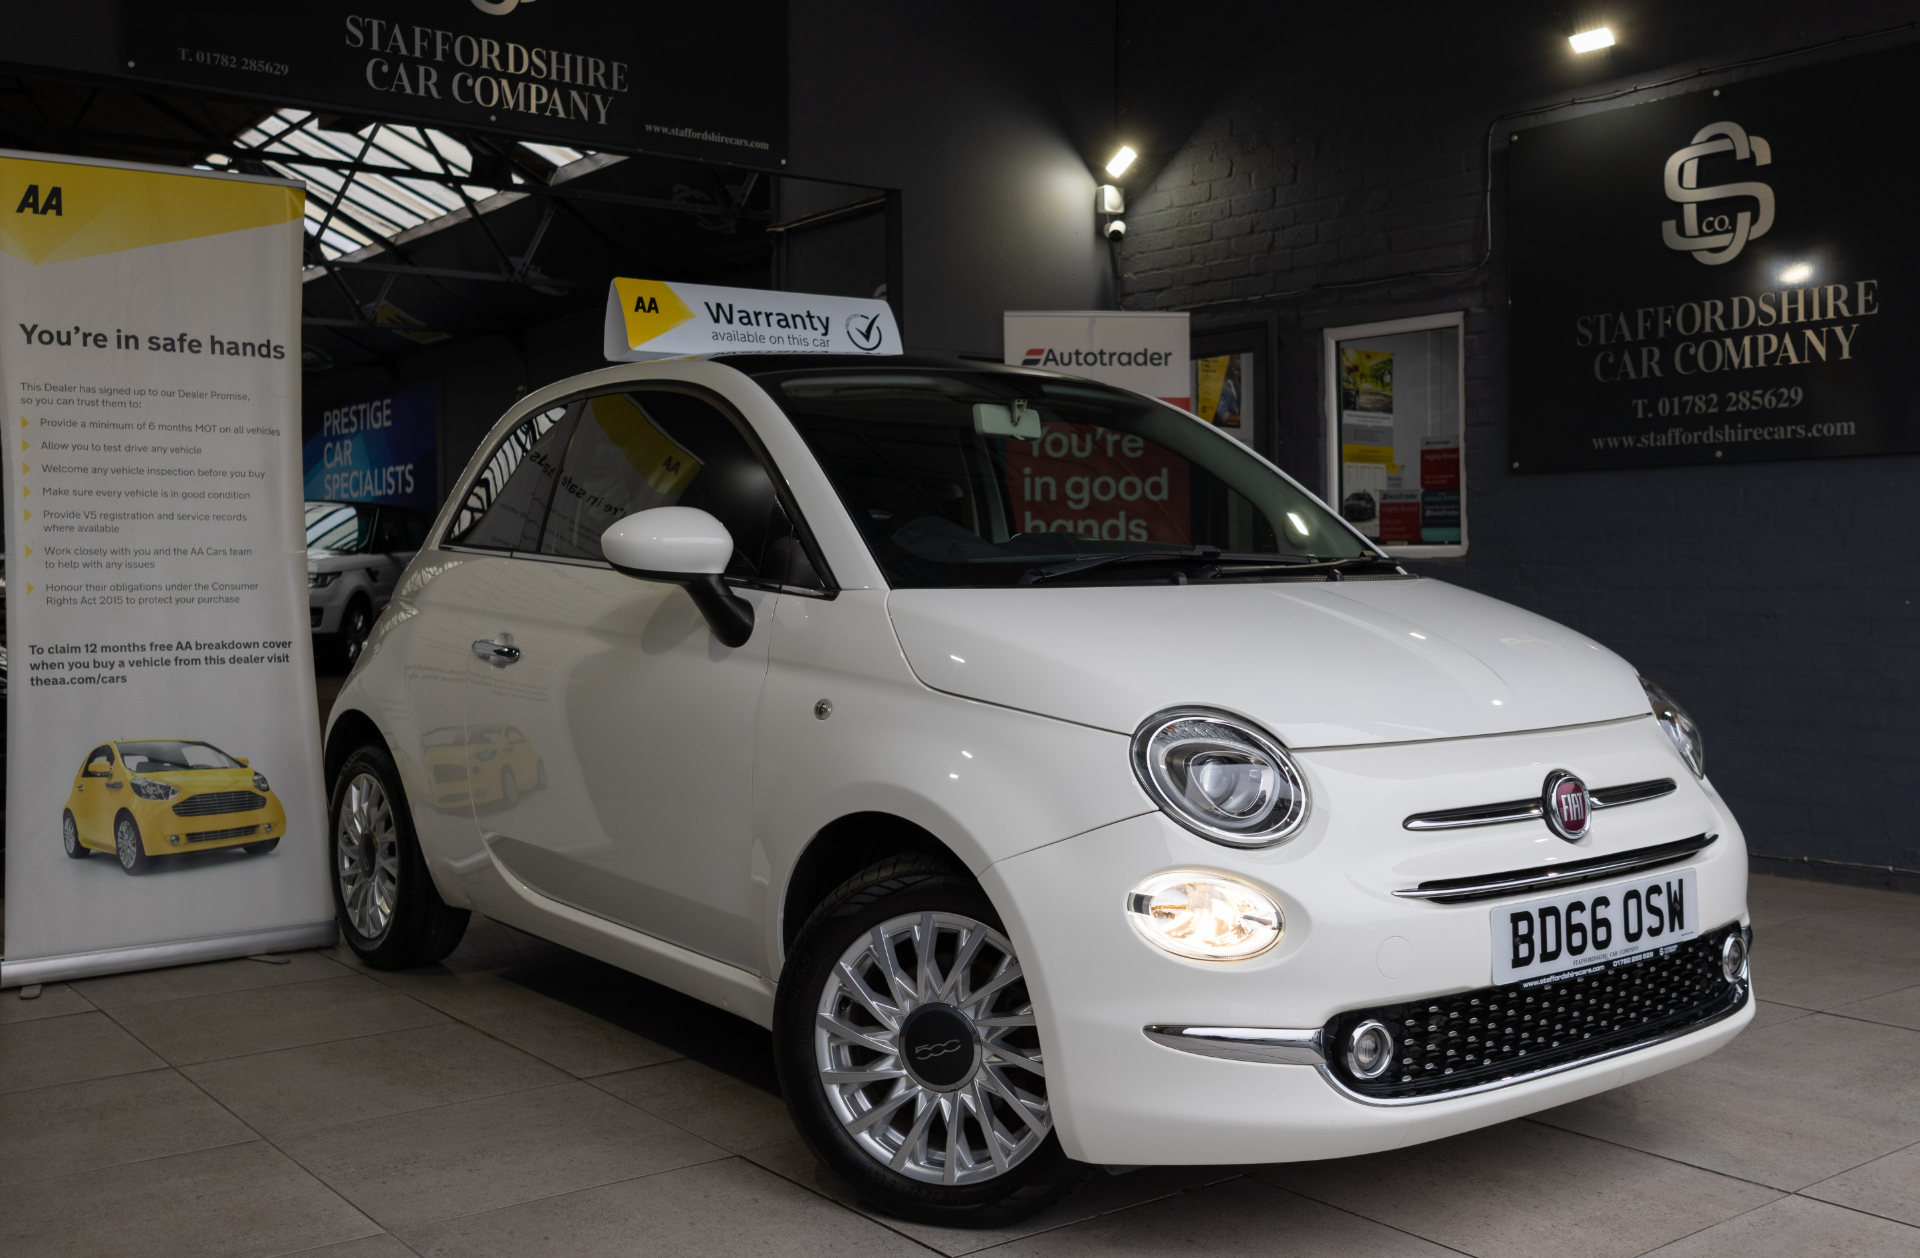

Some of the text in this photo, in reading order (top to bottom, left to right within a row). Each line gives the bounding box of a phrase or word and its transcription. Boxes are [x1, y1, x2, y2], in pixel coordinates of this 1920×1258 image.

[178, 48, 288, 75] T. 01782 285629
[346, 15, 627, 92] STAFFORDSHIRE
[366, 59, 612, 124] CAR COMPANY
[645, 125, 769, 150] www.staffordshirecars.com
[16, 185, 62, 216] AA
[1702, 214, 1732, 233] CO.
[634, 296, 660, 314] AA
[1577, 280, 1878, 346] STAFFORDSHIRE
[703, 301, 831, 337] Warranty
[19, 324, 285, 359] You're in safe hands
[712, 331, 831, 348] available on this car
[1042, 348, 1172, 366] Autotrader
[1594, 324, 1858, 383] CAR COMPANY
[20, 382, 250, 402] This Dealer has signed up to our Dealer Promise,
[21, 397, 141, 409] so you can trust them to:
[1633, 387, 1803, 418] T. 01782 285629
[41, 417, 280, 437] Provide a minimum of 6 months MOT on all vehicles
[324, 398, 392, 437] PRESTIGE
[1593, 422, 1855, 449] www.staffordshirecars.com
[41, 440, 202, 455] Allow you to test drive any vehicle
[324, 439, 352, 469] CAR
[42, 463, 265, 480] Welcome any vehicle inspection before you buy
[324, 463, 414, 501] SPECIALISTS
[1023, 467, 1168, 510] in good
[43, 486, 250, 501] Make sure every vehicle is in good condition
[44, 509, 247, 522] Provide V5 registration and service records
[44, 523, 119, 533] where available
[44, 546, 252, 558] Work closely with you and the AA Cars team
[45, 559, 155, 571] to help with any issues
[46, 581, 258, 594] Honour their obligations under the Consumer
[47, 594, 240, 607] Rights Act 2015 to protect your purchase
[29, 639, 292, 656] To claim 12 months free AA breakdown cover
[30, 653, 289, 672] when you buy a vehicle from this dealer visit
[30, 673, 127, 687] theaa.com/cars
[1560, 792, 1584, 822] FIAT
[1510, 878, 1685, 969] BD66 OSW
[1573, 952, 1608, 966] STAFFORDSHIRE
[1619, 946, 1639, 956] COMPANY
[1522, 964, 1605, 988] www.staffordshirecars.com
[915, 1039, 961, 1060] 500
